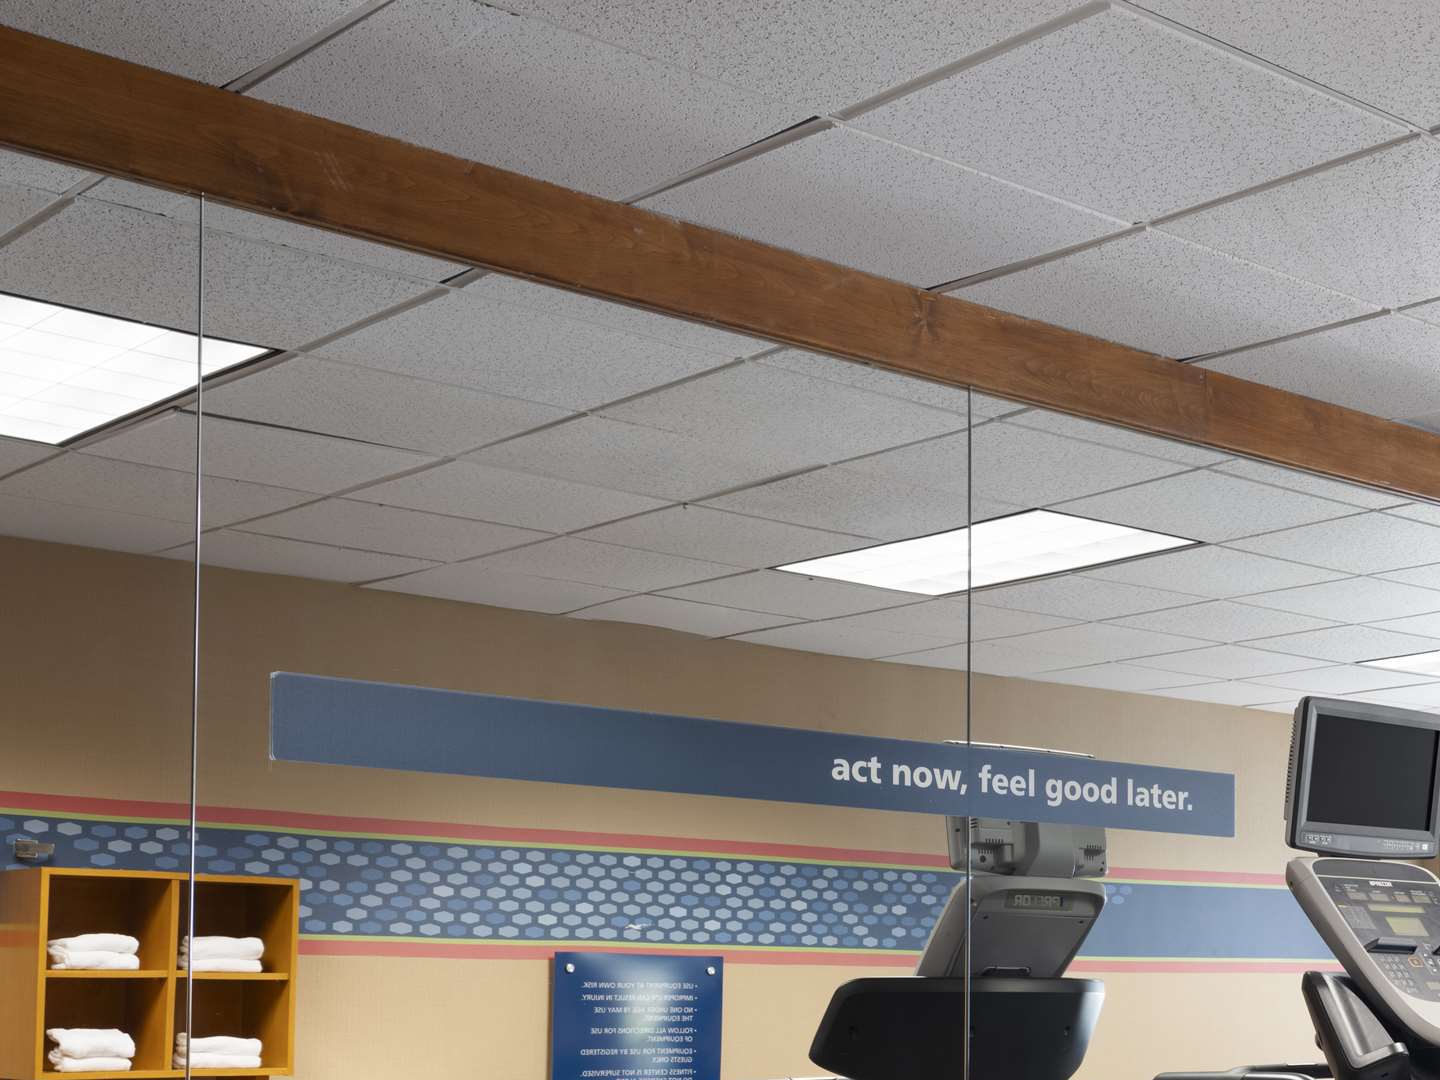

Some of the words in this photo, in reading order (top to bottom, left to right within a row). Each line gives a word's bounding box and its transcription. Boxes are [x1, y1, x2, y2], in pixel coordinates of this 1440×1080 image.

[831, 756, 881, 785] act
[892, 762, 968, 795] now,
[978, 765, 1035, 798] feel
[1045, 777, 1117, 808] good
[1127, 779, 1193, 811] later.
